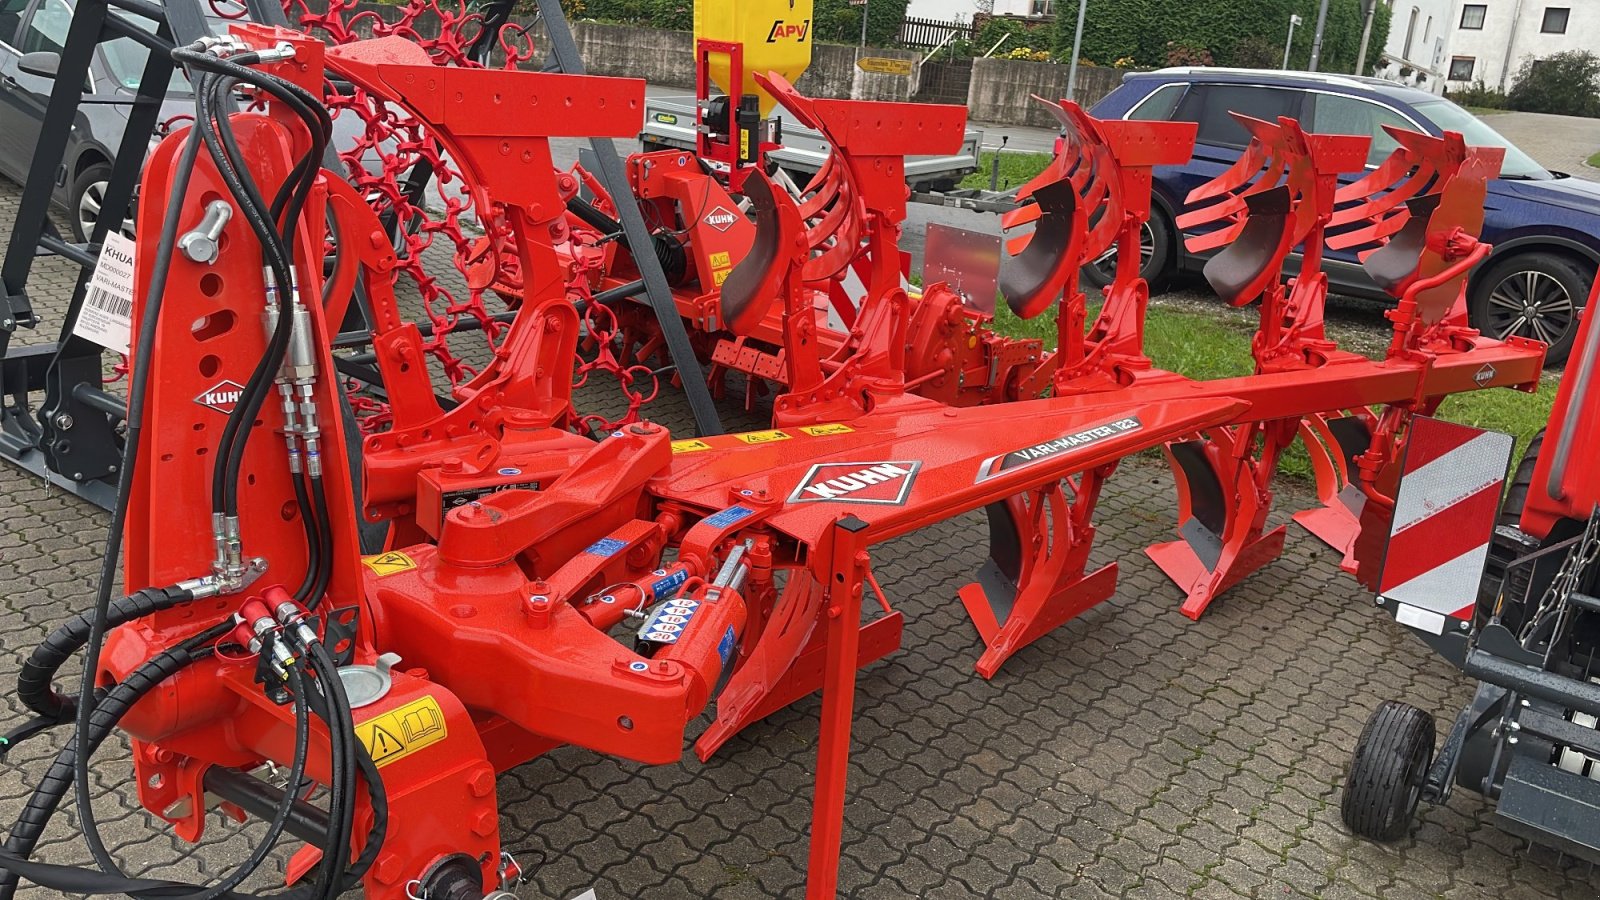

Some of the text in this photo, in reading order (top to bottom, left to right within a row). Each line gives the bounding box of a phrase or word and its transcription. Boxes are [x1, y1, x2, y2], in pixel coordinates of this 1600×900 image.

[709, 214, 734, 225] KUHN
[105, 246, 133, 267] KHUA
[1476, 369, 1494, 381] KUHN
[1014, 418, 1140, 460] VARI-MASTER 123
[803, 463, 911, 498] KUHN
[653, 631, 671, 640] 20
